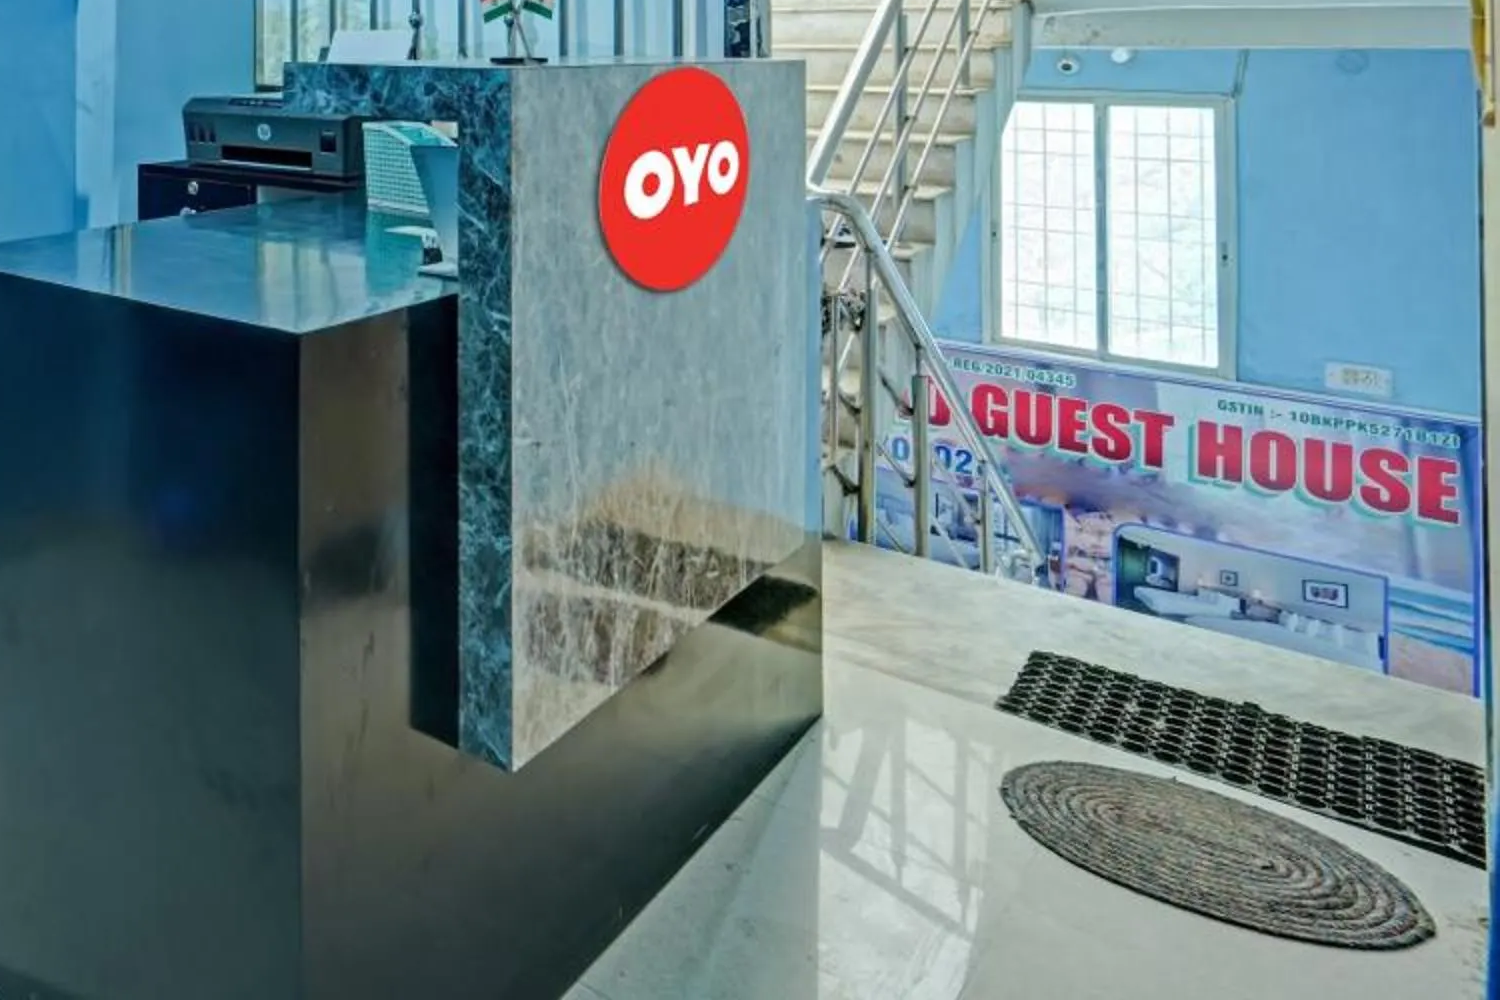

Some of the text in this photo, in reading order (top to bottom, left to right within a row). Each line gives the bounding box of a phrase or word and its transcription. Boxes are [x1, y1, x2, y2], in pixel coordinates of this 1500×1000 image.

[624, 140, 740, 220] OYO
[1217, 399, 1264, 416] GSTIN
[971, 383, 1175, 469] GUEST
[1197, 415, 1460, 524] HOUSE
